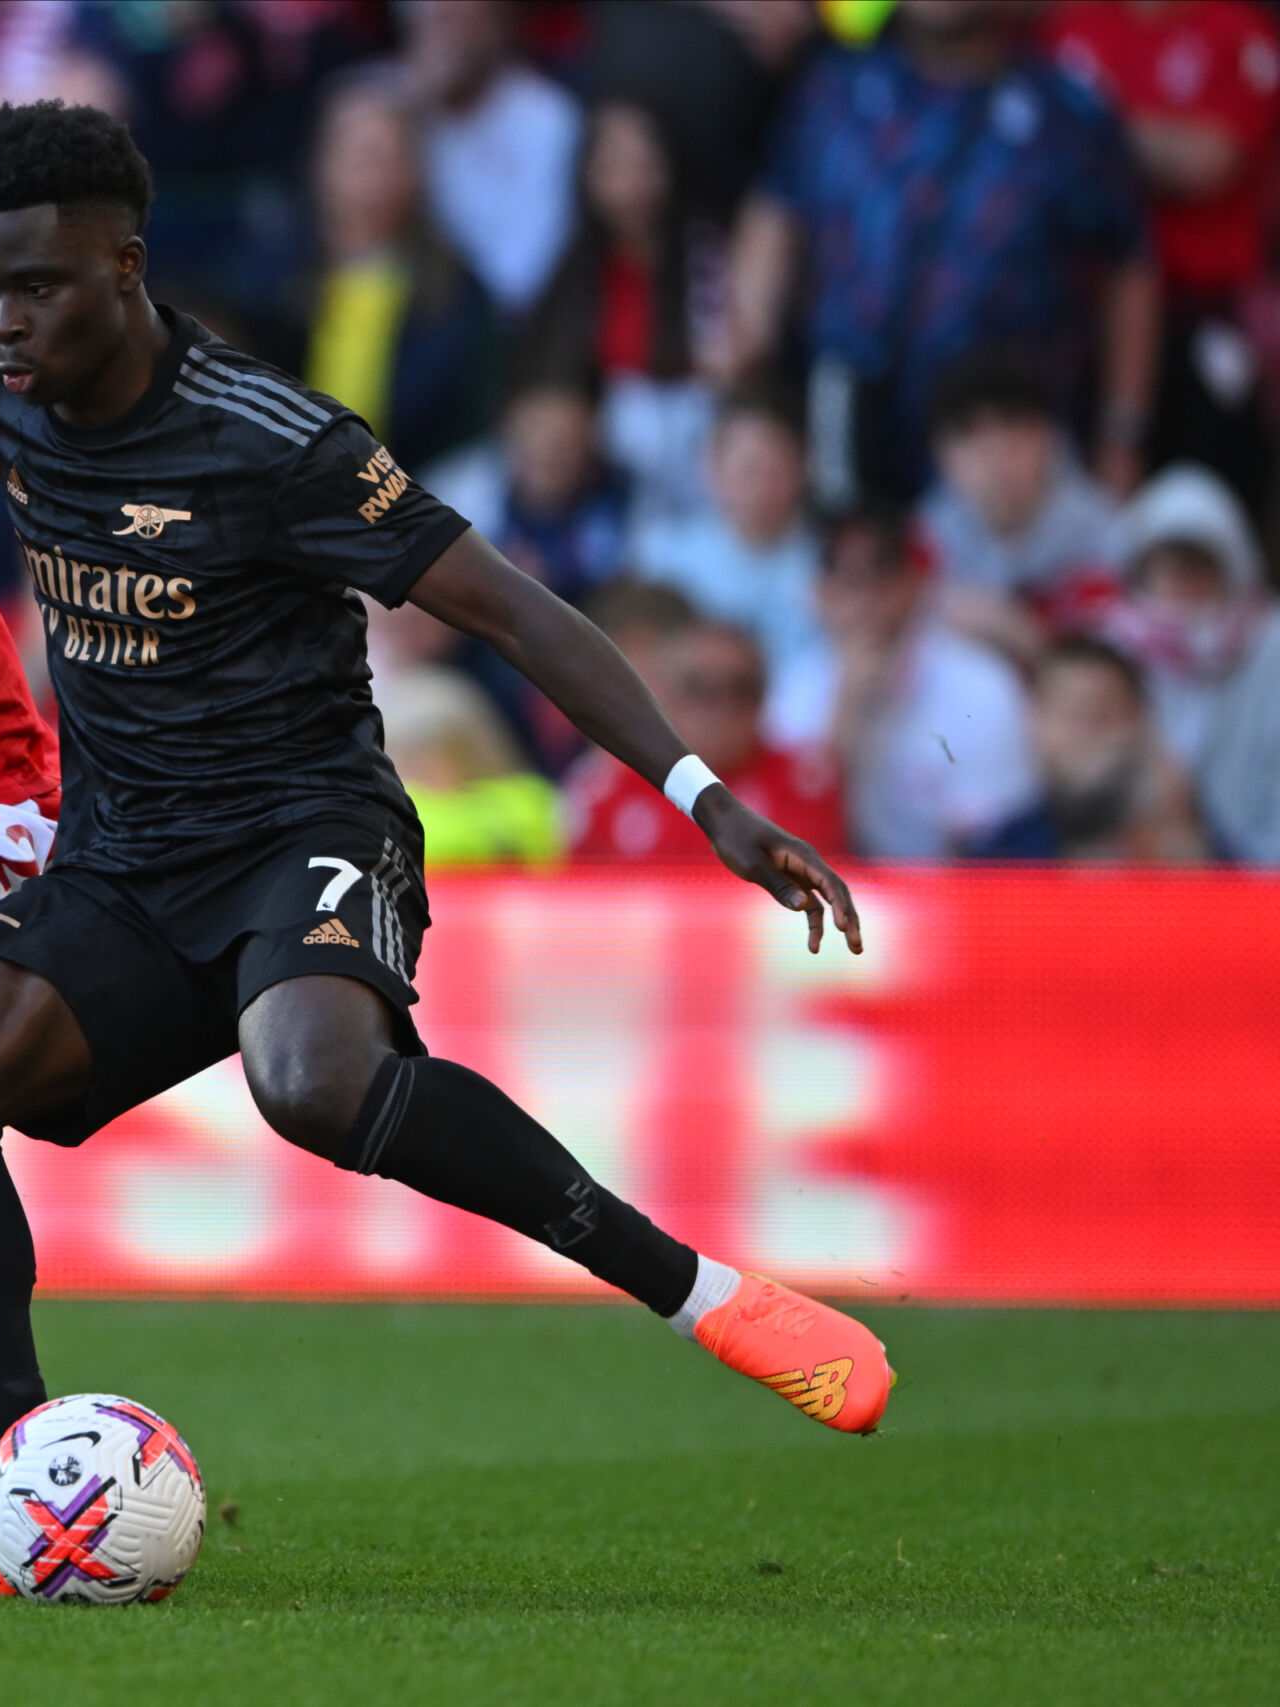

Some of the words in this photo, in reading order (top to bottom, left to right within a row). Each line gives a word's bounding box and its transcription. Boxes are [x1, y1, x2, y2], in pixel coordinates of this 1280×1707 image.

[20, 540, 197, 620] mirates
[63, 614, 161, 666] BETTER
[307, 856, 364, 912] 7
[302, 933, 360, 949] adidas
